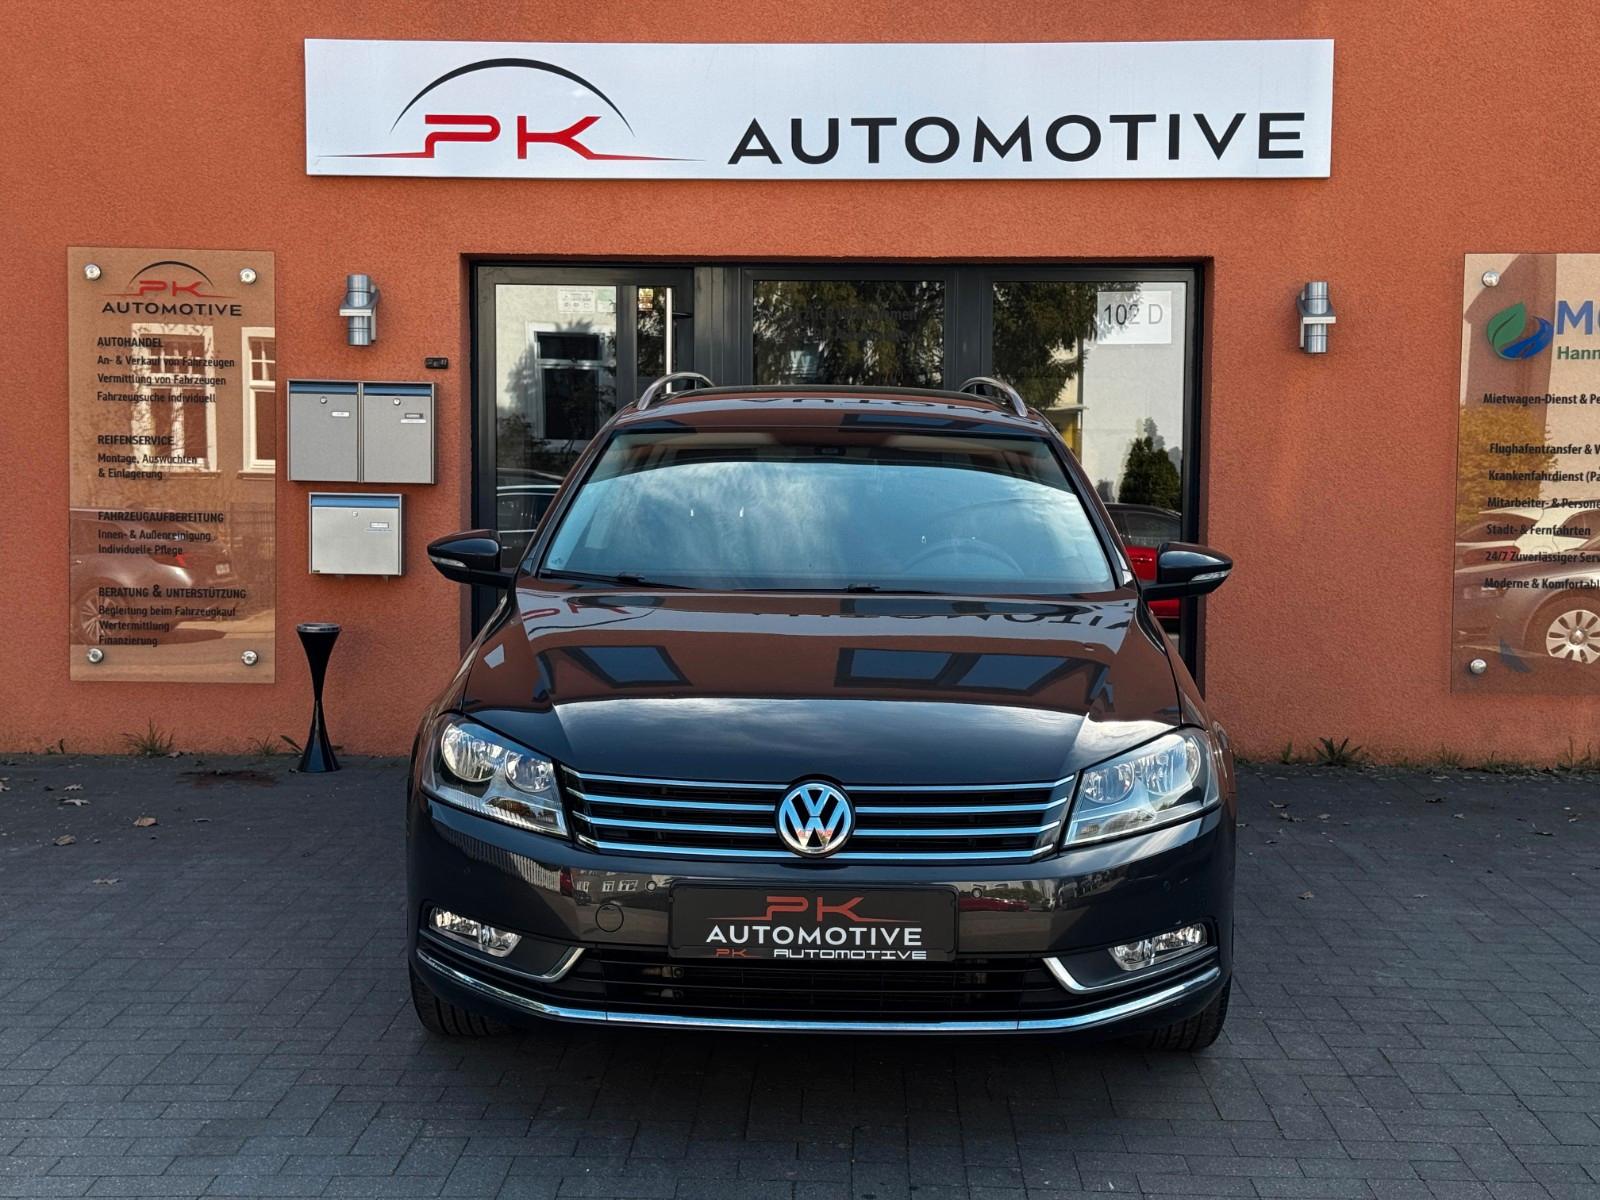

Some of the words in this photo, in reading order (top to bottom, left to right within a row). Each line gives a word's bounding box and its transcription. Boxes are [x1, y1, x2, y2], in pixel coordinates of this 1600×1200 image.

[424, 114, 602, 161] PK
[727, 112, 1305, 165] AUTOMOTIVE
[139, 280, 202, 297] PK
[101, 301, 243, 317] AUTOMOTIVE
[1103, 303, 1141, 326] 102
[1147, 303, 1164, 325] D
[1556, 300, 1600, 335] M
[97, 336, 164, 348] AUTOHANDEL
[97, 355, 113, 366] An-
[115, 356, 123, 365] &
[125, 356, 161, 366] Verkauf
[163, 358, 180, 367] von
[182, 357, 235, 369] Fahrzeugen
[97, 373, 152, 386] Vermittlung
[154, 375, 171, 385] von
[173, 374, 226, 387] Fahrzeugen
[97, 391, 166, 404] Fahrzeugsuche
[168, 392, 217, 403] individuell
[1483, 393, 1577, 407] Mietwagen-Dienst
[1579, 393, 1588, 404] &
[97, 434, 175, 446] REIFENSERVICE
[1489, 443, 1582, 456] Flughafentransfer
[1584, 444, 1592, 455] &
[142, 453, 198, 465] Auswuchten
[98, 468, 105, 478] &
[108, 468, 163, 481] Einlagerung
[1488, 470, 1583, 482] Krankenfahrdienst
[1487, 497, 1549, 508] Mitarbeiter-
[1551, 498, 1560, 508] &
[97, 511, 225, 523] FAHRZEUGAUFBEREITUNG
[97, 529, 127, 540] Innen-
[129, 530, 137, 540] &
[139, 529, 211, 542] Außenreinigung
[1486, 523, 1518, 535] Stadt-
[1519, 524, 1528, 535] &
[1530, 523, 1591, 536] Fernfahrten
[98, 543, 151, 555] Individuelle
[154, 544, 183, 557] Pflege
[1485, 551, 1508, 562] 24/7
[1510, 552, 1577, 565] Zuverlässiger
[1484, 577, 1530, 589] Moderne
[1531, 577, 1540, 588] &
[98, 586, 149, 598] BERATUNG
[152, 584, 162, 598] &
[166, 586, 247, 599] UNTERSTÜTZUNG
[98, 605, 148, 617] Begleitung
[150, 605, 172, 616] beim
[174, 606, 236, 618] Fahrzeugkauf
[98, 620, 170, 632] Wertermittlung
[98, 635, 158, 648] Finanzierung
[766, 895, 865, 922] PK
[705, 924, 923, 946] AUTOMOTIVE
[715, 947, 748, 958] PK
[773, 949, 928, 960] AUTOMOTIVE
